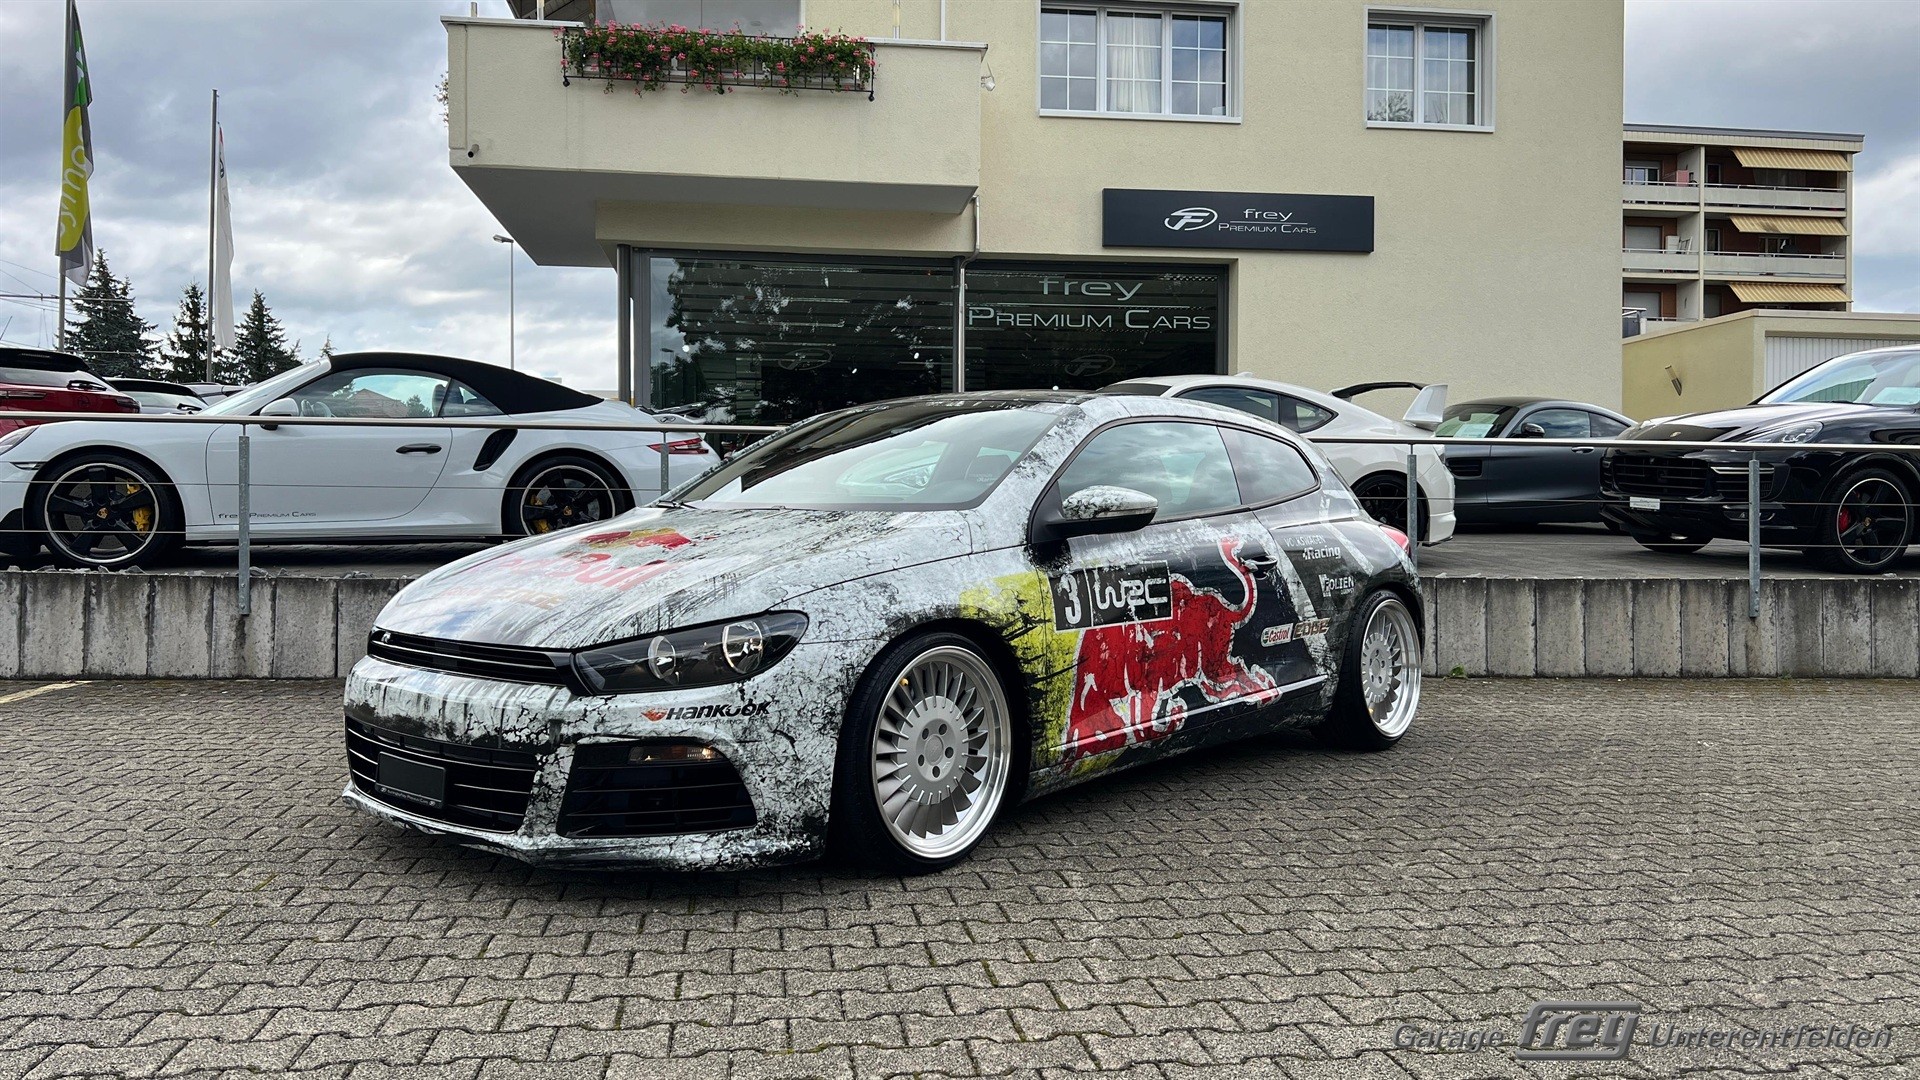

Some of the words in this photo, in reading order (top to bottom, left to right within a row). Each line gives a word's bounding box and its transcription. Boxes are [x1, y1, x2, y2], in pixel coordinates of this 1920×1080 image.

[1243, 208, 1292, 221] frey
[1218, 222, 1277, 233] PREMIUM
[1281, 224, 1316, 234] CARS
[1039, 278, 1143, 301] frey
[968, 306, 1112, 328] PREMIUM
[1125, 309, 1211, 330] CARS
[1304, 545, 1341, 560] Racing
[1058, 572, 1082, 625] 3
[1093, 577, 1168, 610] WRC
[1268, 626, 1290, 642] Castrol
